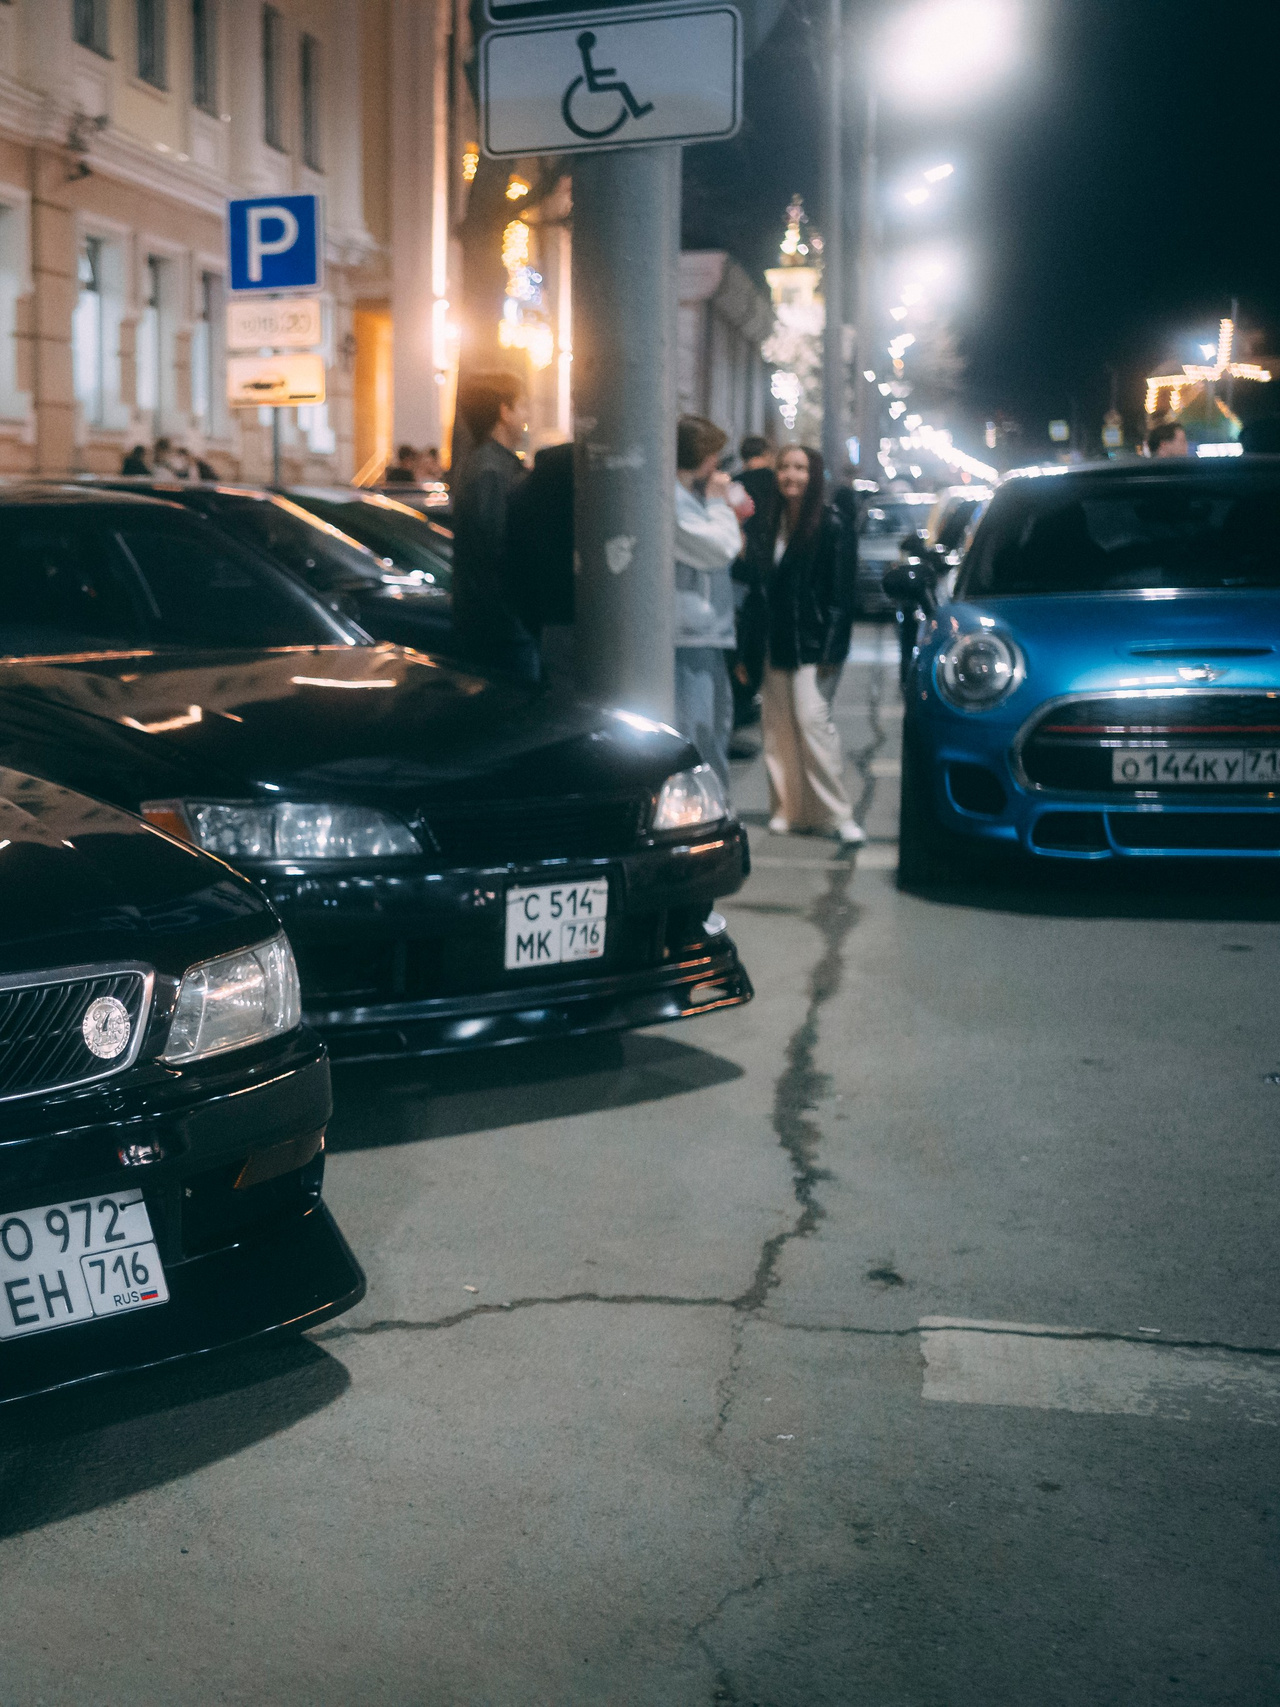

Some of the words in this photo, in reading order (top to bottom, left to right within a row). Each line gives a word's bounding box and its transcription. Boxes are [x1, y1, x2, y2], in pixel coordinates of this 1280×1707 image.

[246, 206, 299, 282] P
[1247, 750, 1280, 773] 71
[550, 888, 592, 918] 514
[567, 922, 600, 947] 716
[45, 1198, 126, 1253] 972
[88, 1251, 150, 1294] 716
[113, 1291, 140, 1307] RUS
